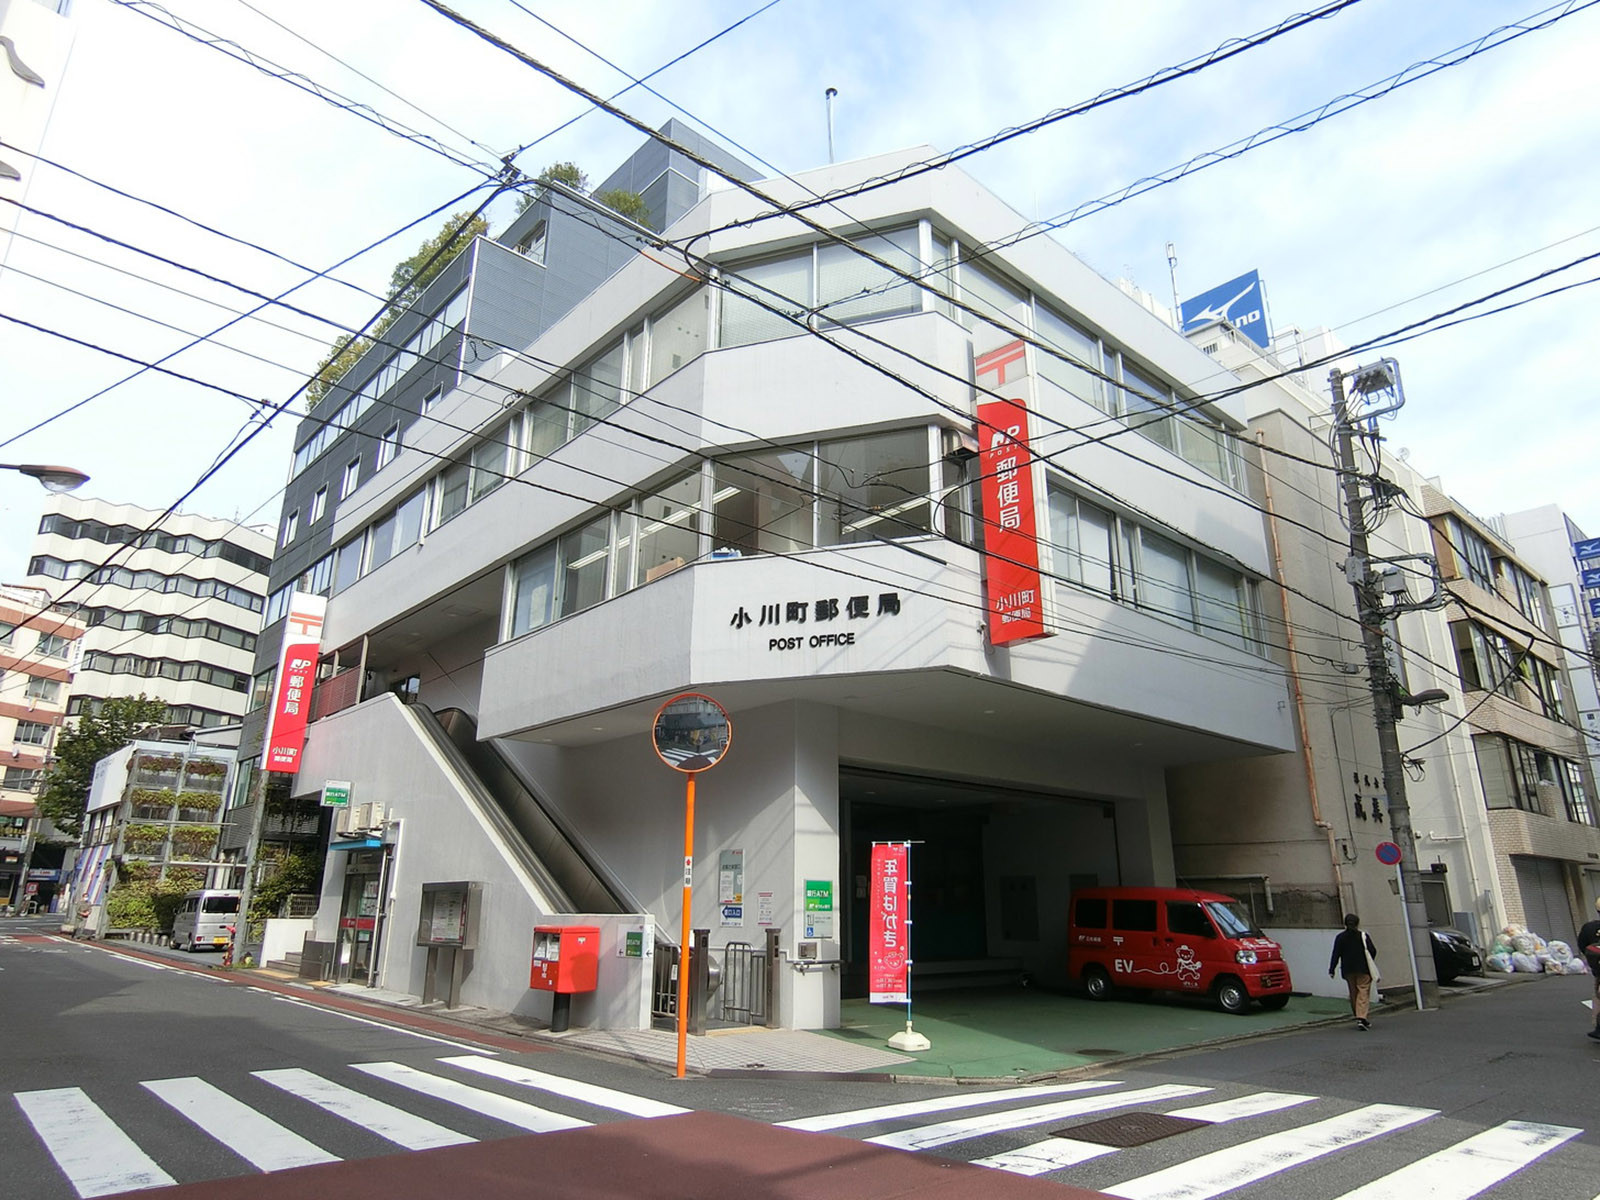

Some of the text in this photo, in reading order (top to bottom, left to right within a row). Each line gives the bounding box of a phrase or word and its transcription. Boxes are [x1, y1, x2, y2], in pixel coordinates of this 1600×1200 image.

[989, 444, 1018, 459] POST
[996, 456, 1021, 533] 郵便局
[730, 592, 900, 630] 小川町郵便局
[996, 589, 1035, 612] 小川町
[769, 632, 855, 651] POST OFFICE
[283, 675, 304, 715] 郵便局
[1115, 959, 1133, 973] EV
